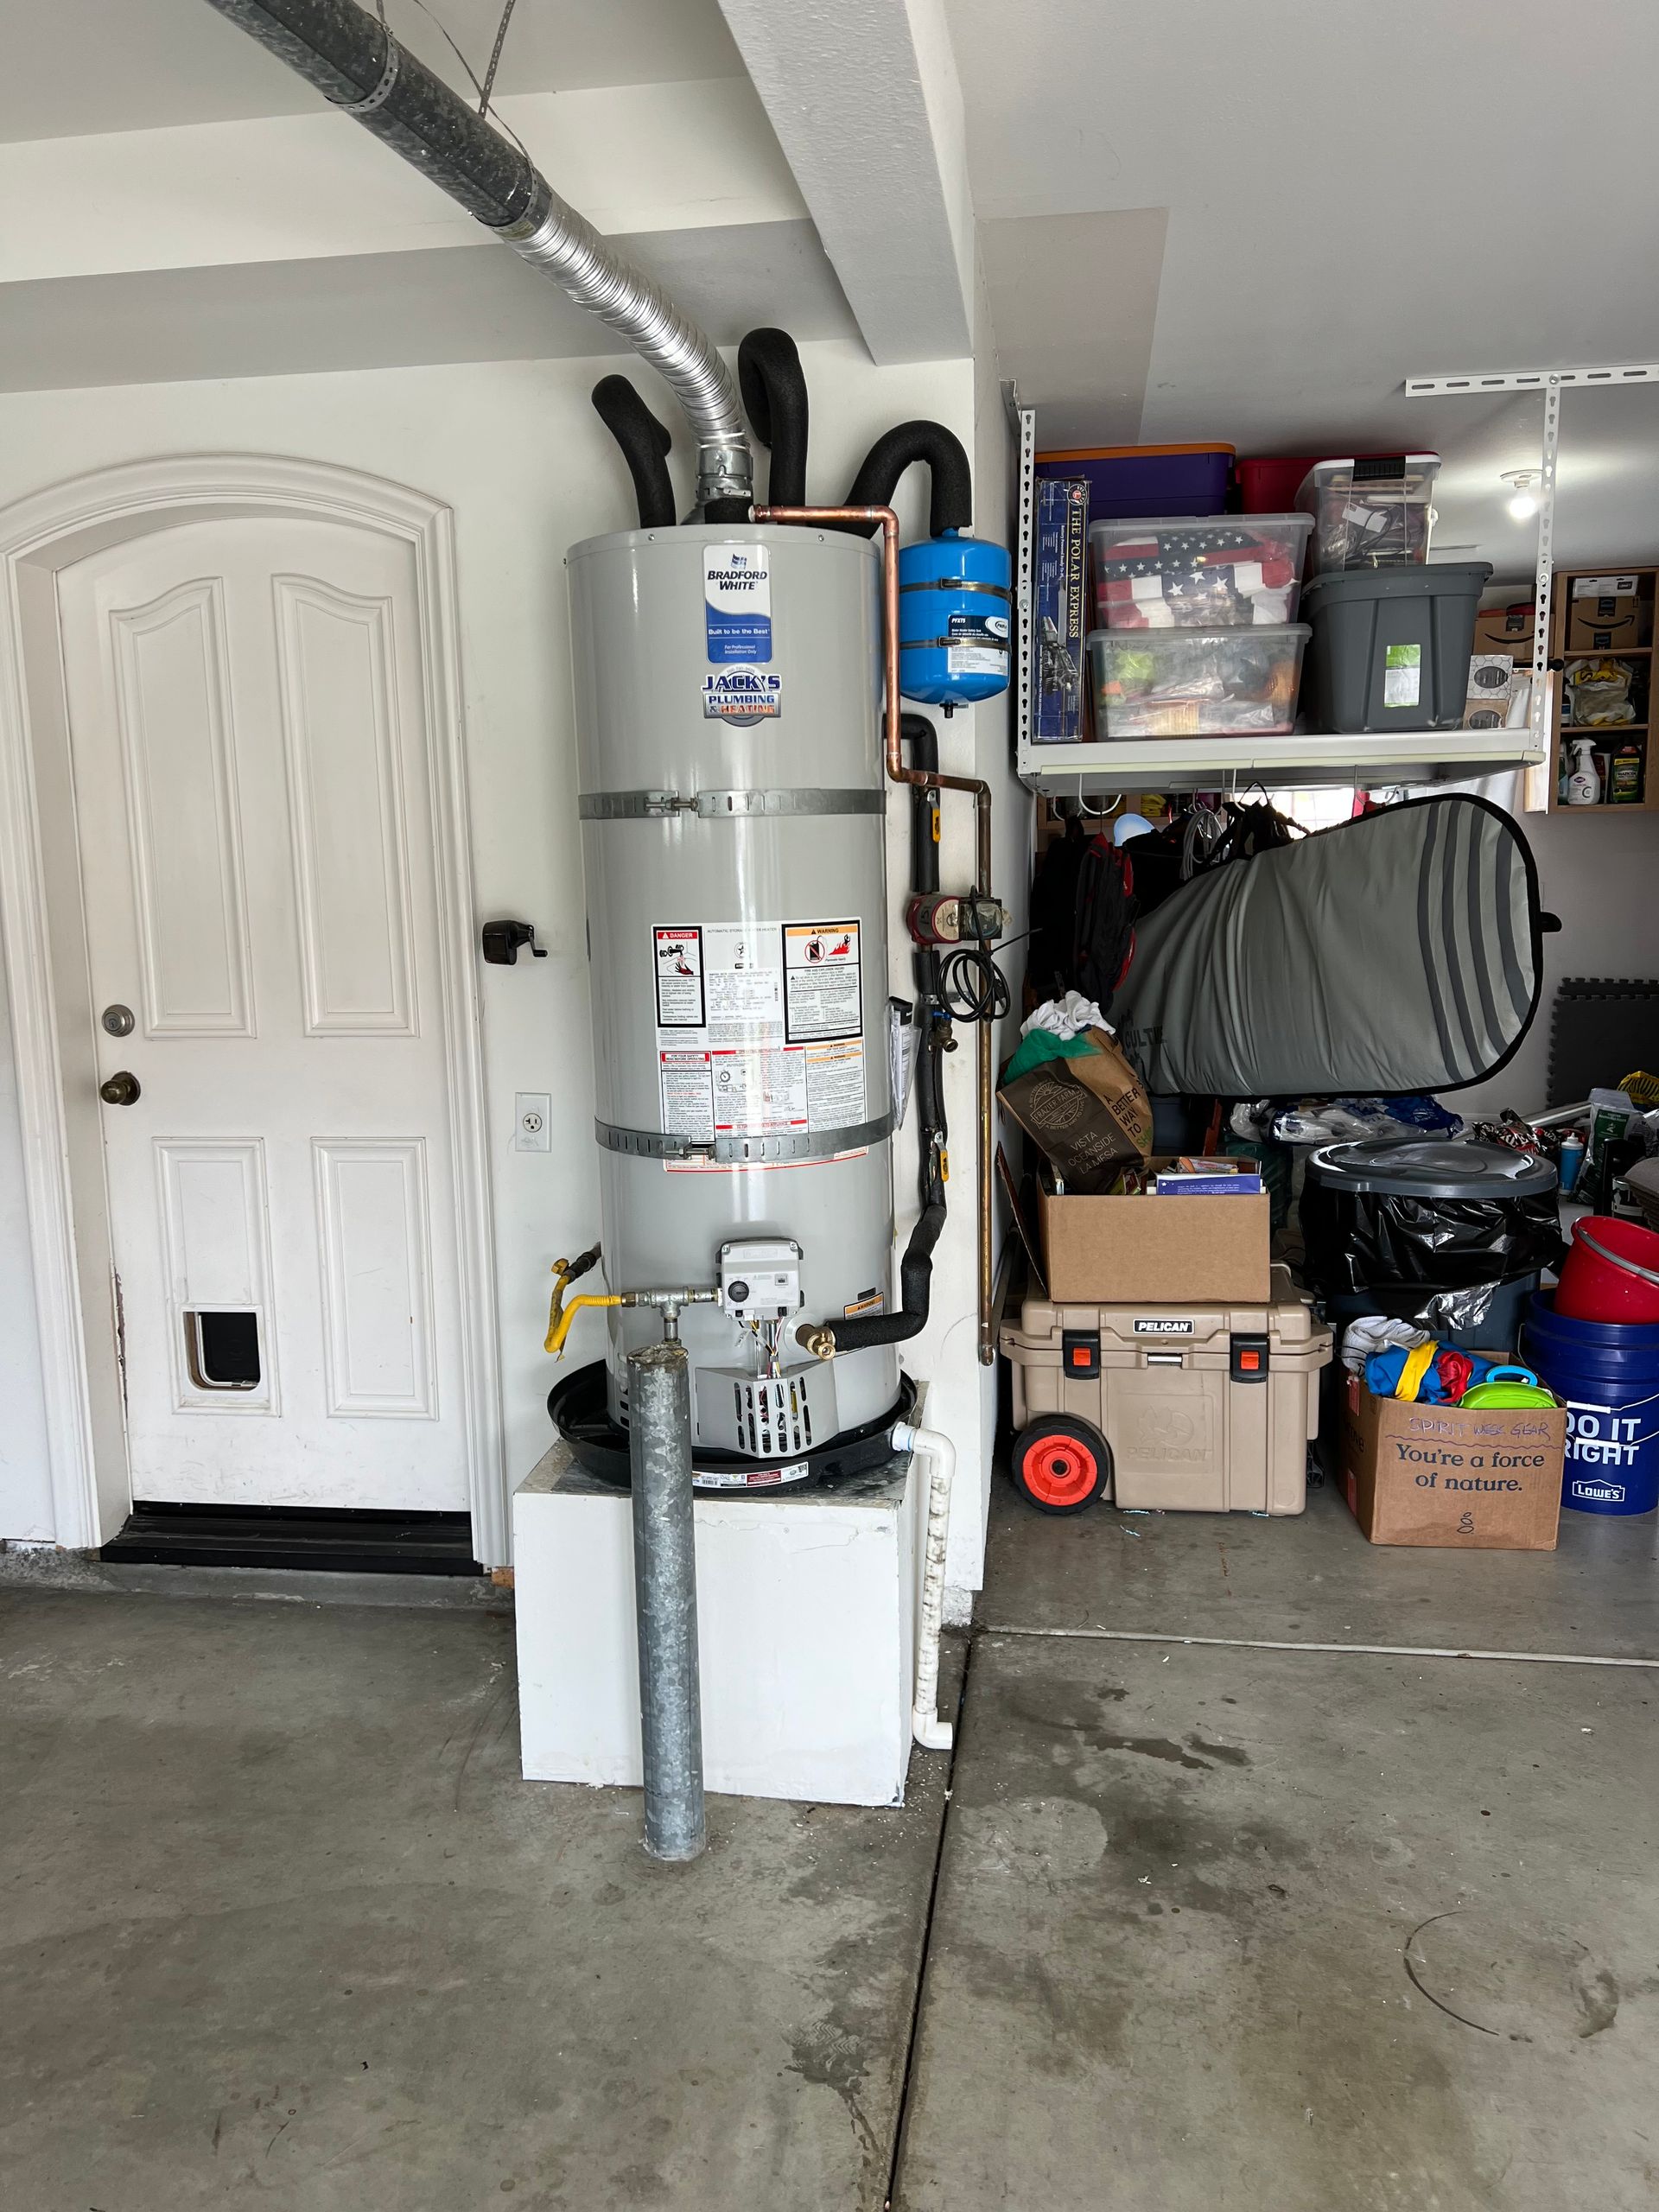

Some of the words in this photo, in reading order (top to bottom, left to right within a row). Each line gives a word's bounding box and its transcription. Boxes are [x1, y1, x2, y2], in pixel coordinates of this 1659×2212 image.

[1071, 509, 1082, 534] THE
[1071, 539, 1081, 582] POLAR
[707, 571, 767, 580] BRADFORD
[719, 581, 755, 590] WHITE
[1069, 586, 1080, 638] EXPRESS
[702, 676, 780, 690] JACK'S
[709, 695, 775, 704] PLUMBING
[1103, 1095, 1113, 1105] A
[1111, 1088, 1141, 1116] BETTER
[1033, 1100, 1057, 1121] FRAZIER
[1119, 1107, 1138, 1126] WAY
[1127, 1123, 1141, 1138] TO
[1068, 1132, 1116, 1166] OCEANSIDE
[1071, 1131, 1098, 1151] VISTA
[1079, 1163, 1092, 1174] LA
[1138, 1322, 1189, 1332] PELICAN
[1409, 1417, 1469, 1437] SPIRIT
[1510, 1422, 1551, 1441] GEAR
[1611, 1418, 1641, 1441] IT
[1396, 1443, 1464, 1466] You're
[1470, 1455, 1484, 1467] a
[1491, 1452, 1545, 1467] force
[1415, 1472, 1438, 1488] of
[1445, 1477, 1522, 1491] nature.
[1578, 1484, 1620, 1499] LOWE'S
